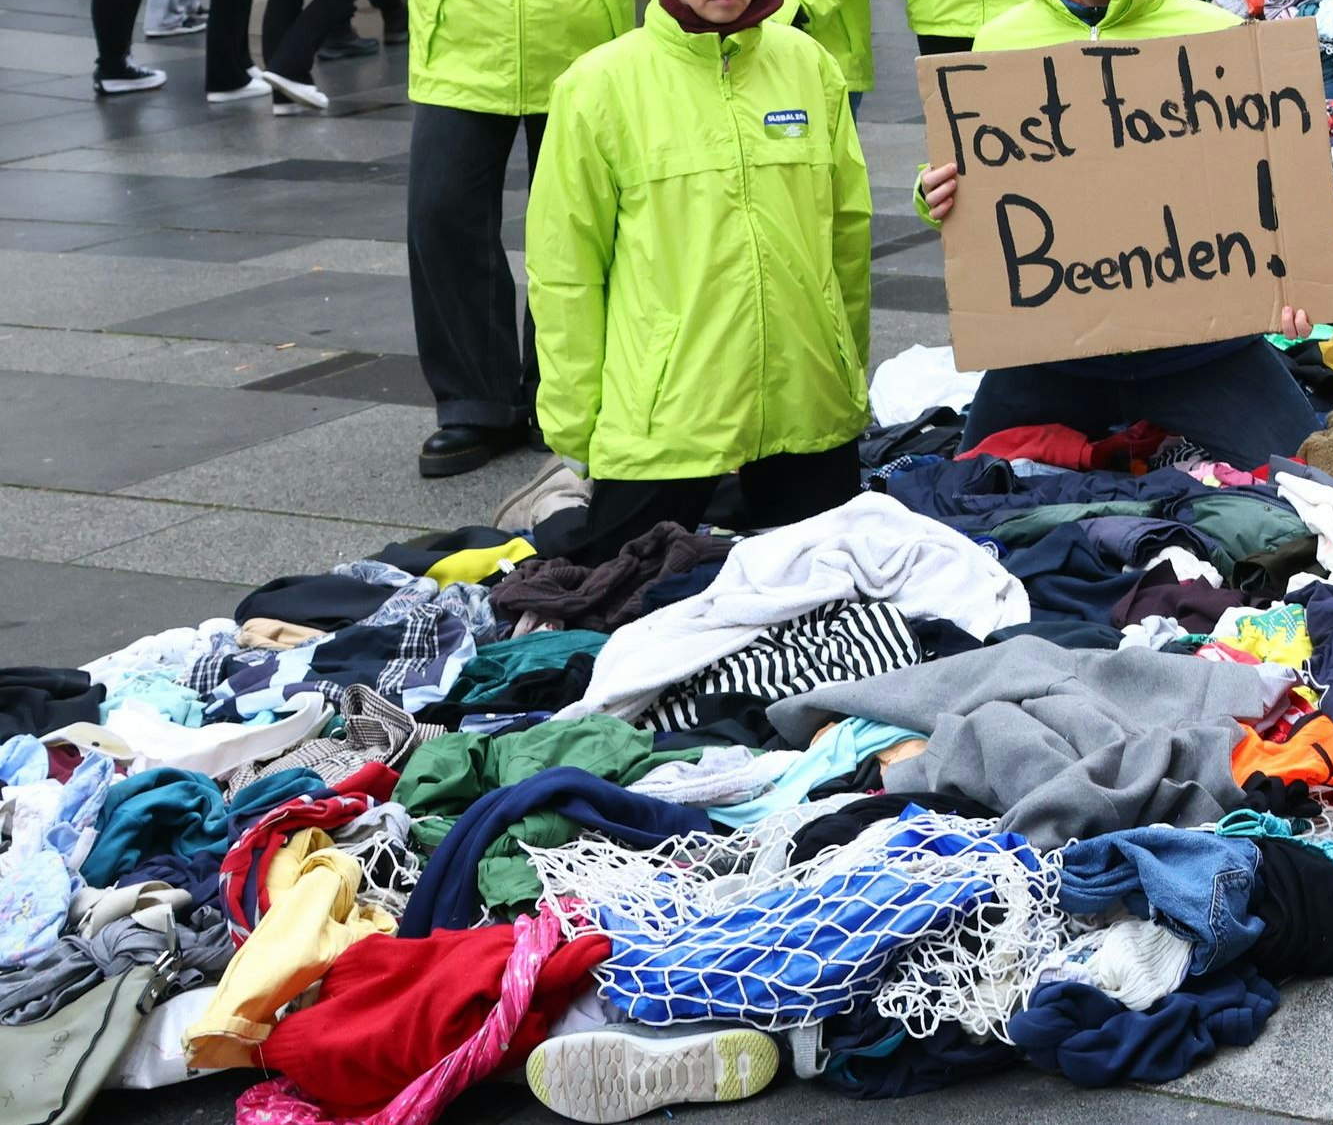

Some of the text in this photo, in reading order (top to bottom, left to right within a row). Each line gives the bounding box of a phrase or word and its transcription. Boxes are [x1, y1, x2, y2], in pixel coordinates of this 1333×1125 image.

[767, 113, 794, 122] GLOBAL
[936, 45, 1311, 176] Fast Fashion
[995, 159, 1287, 308] Beenden!
